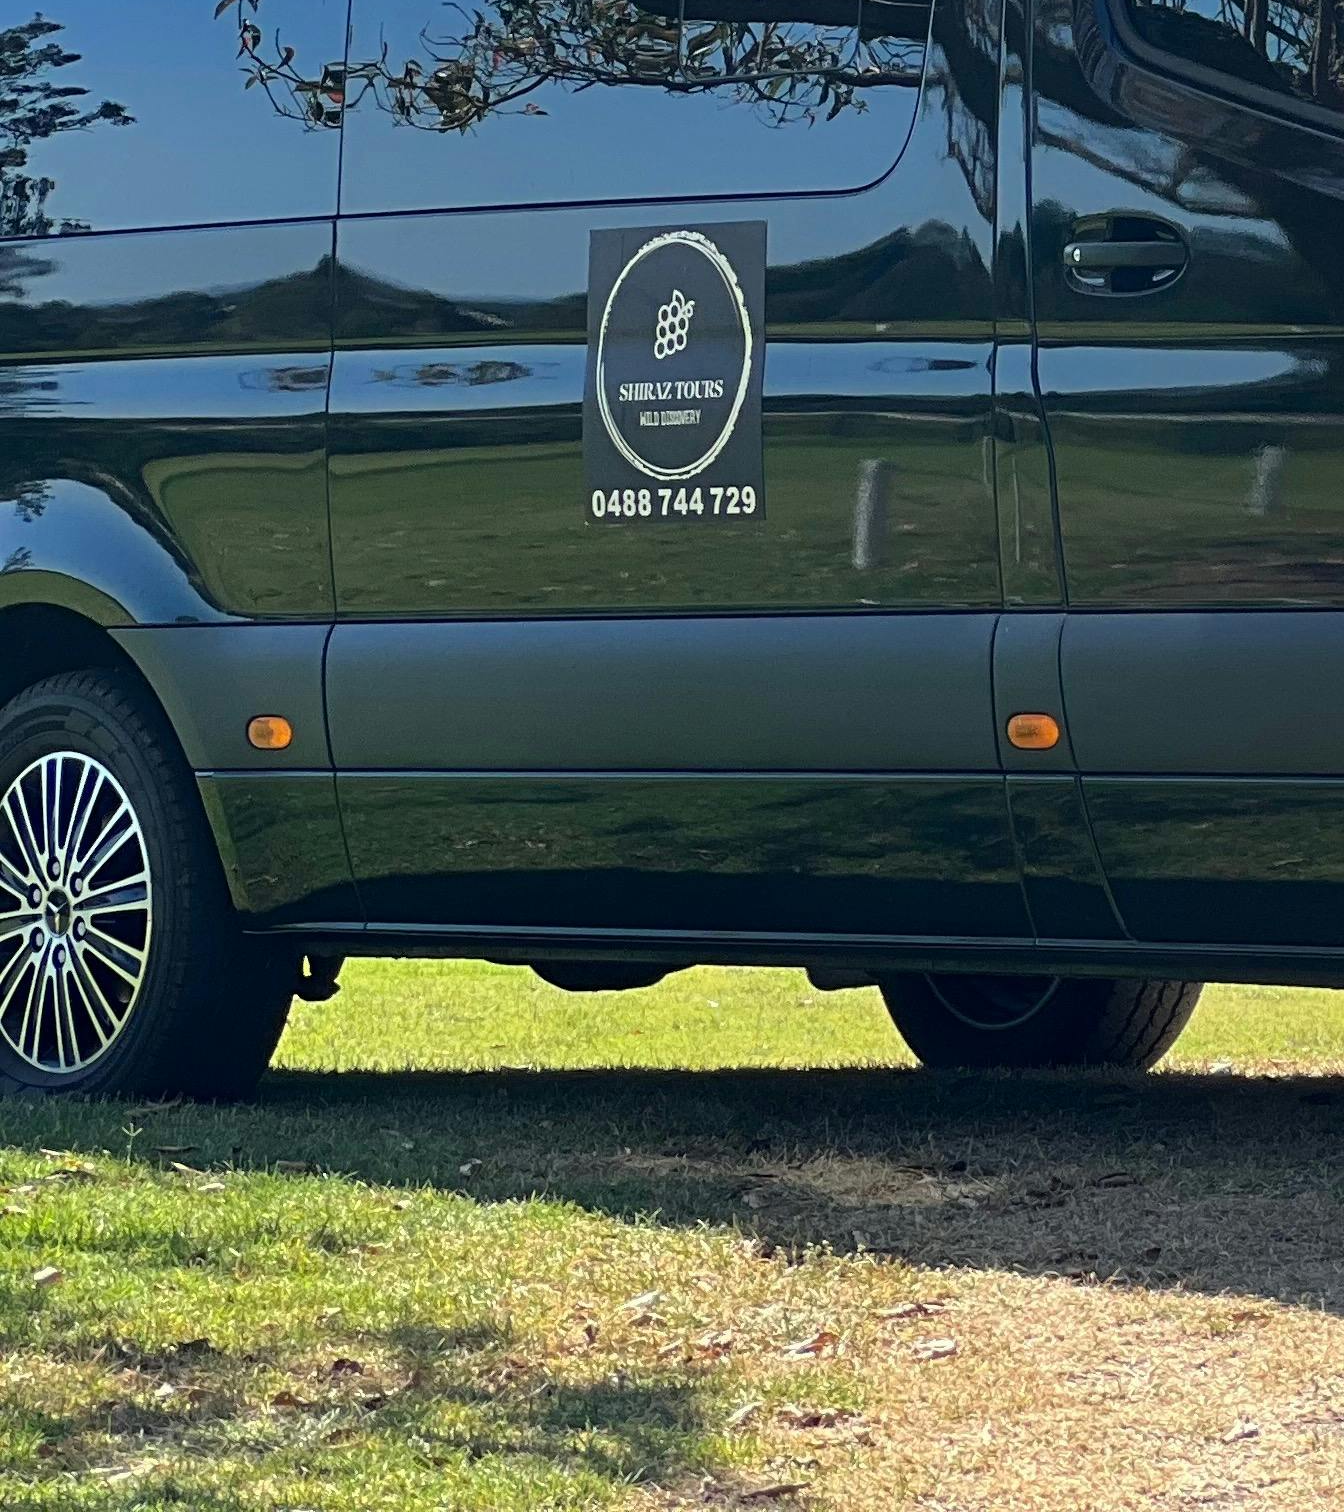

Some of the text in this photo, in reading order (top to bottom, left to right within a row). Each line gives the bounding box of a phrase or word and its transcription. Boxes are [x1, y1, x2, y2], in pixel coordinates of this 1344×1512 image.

[619, 379, 724, 401] SHIRAZ TOURS
[592, 485, 756, 518] 0488 744 729
